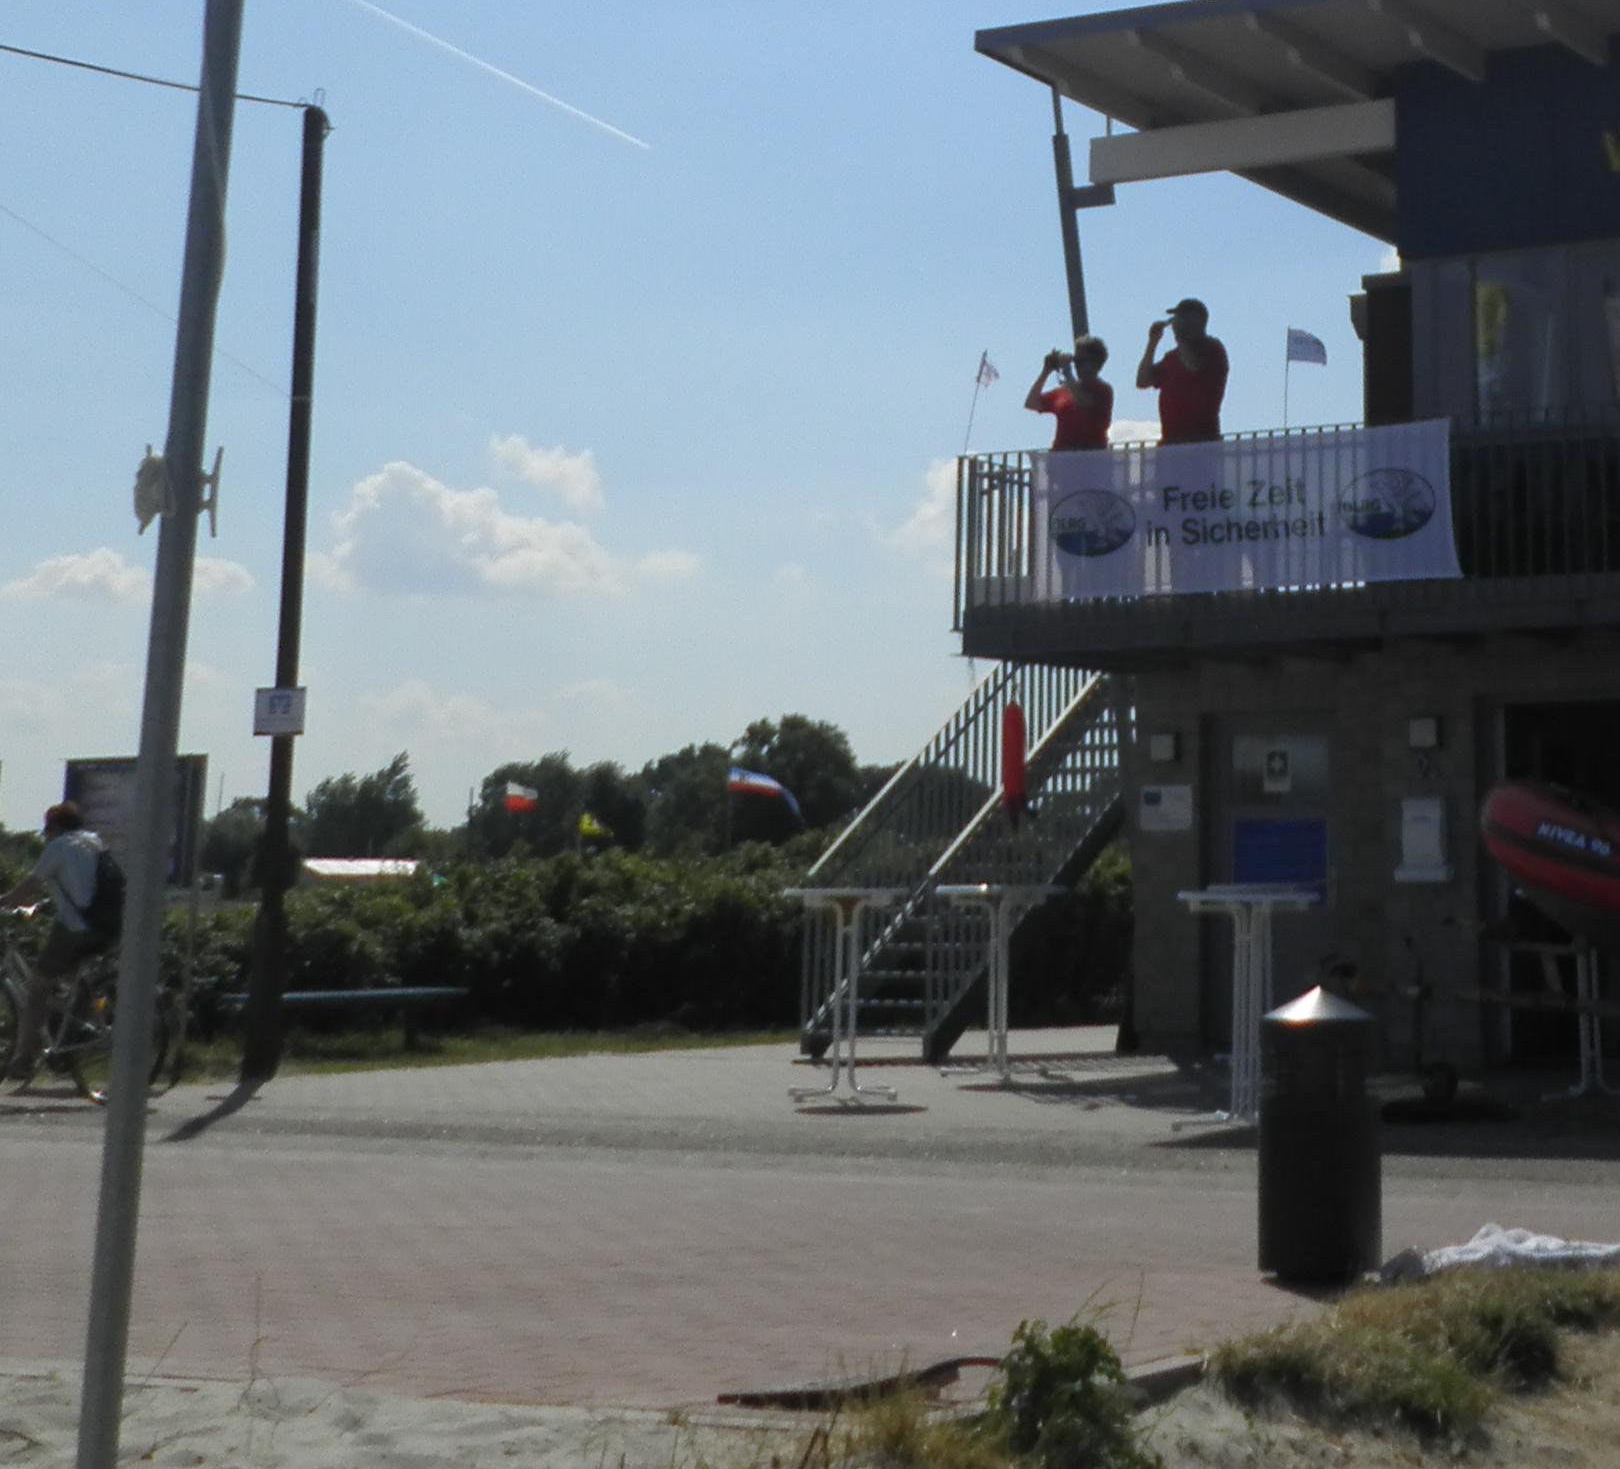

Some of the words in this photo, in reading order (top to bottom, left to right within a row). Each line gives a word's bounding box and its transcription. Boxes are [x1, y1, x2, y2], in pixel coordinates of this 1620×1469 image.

[1162, 483, 1235, 512] Freie
[1247, 476, 1306, 508] Zeit
[1146, 519, 1171, 547] in
[1181, 509, 1327, 546] Sicherheit
